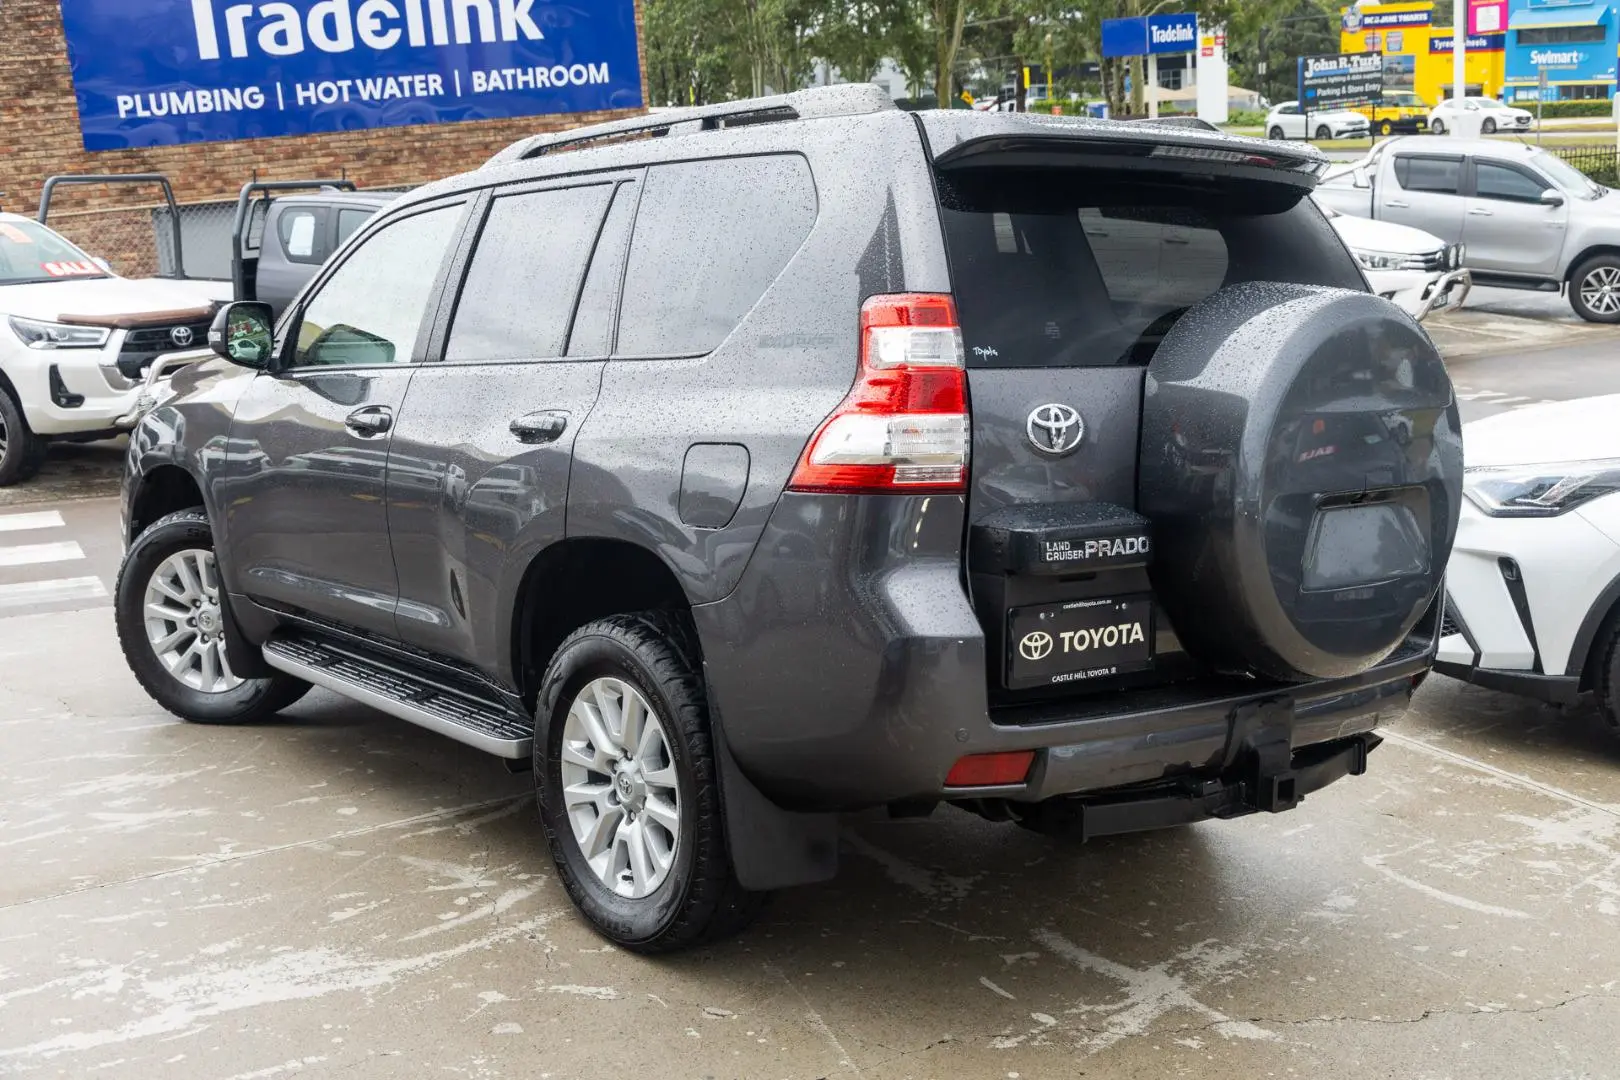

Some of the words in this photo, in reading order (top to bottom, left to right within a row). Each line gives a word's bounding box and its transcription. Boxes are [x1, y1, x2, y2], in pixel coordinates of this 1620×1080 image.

[191, 0, 545, 60] Tradelink
[1150, 23, 1195, 44] Tradelink
[1304, 58, 1338, 78] John
[1338, 57, 1351, 69] R.
[1350, 53, 1382, 68] Turk
[1529, 50, 1579, 65] Swimart
[116, 86, 265, 119] PLUMBING
[295, 79, 352, 106] HOT
[355, 73, 445, 101] WATER
[471, 62, 610, 93] BATHROOM
[1316, 88, 1341, 97] Parking
[1347, 84, 1364, 94] Store
[1364, 83, 1382, 93] Entry
[1046, 541, 1071, 552] LAND
[1046, 550, 1084, 561] CRUISER
[1085, 536, 1149, 559] PRADO
[1060, 622, 1145, 653] TOYOTA
[1052, 673, 1073, 683] CASTLE
[1074, 671, 1086, 680] HILL
[1087, 668, 1109, 678] TOYOTA
